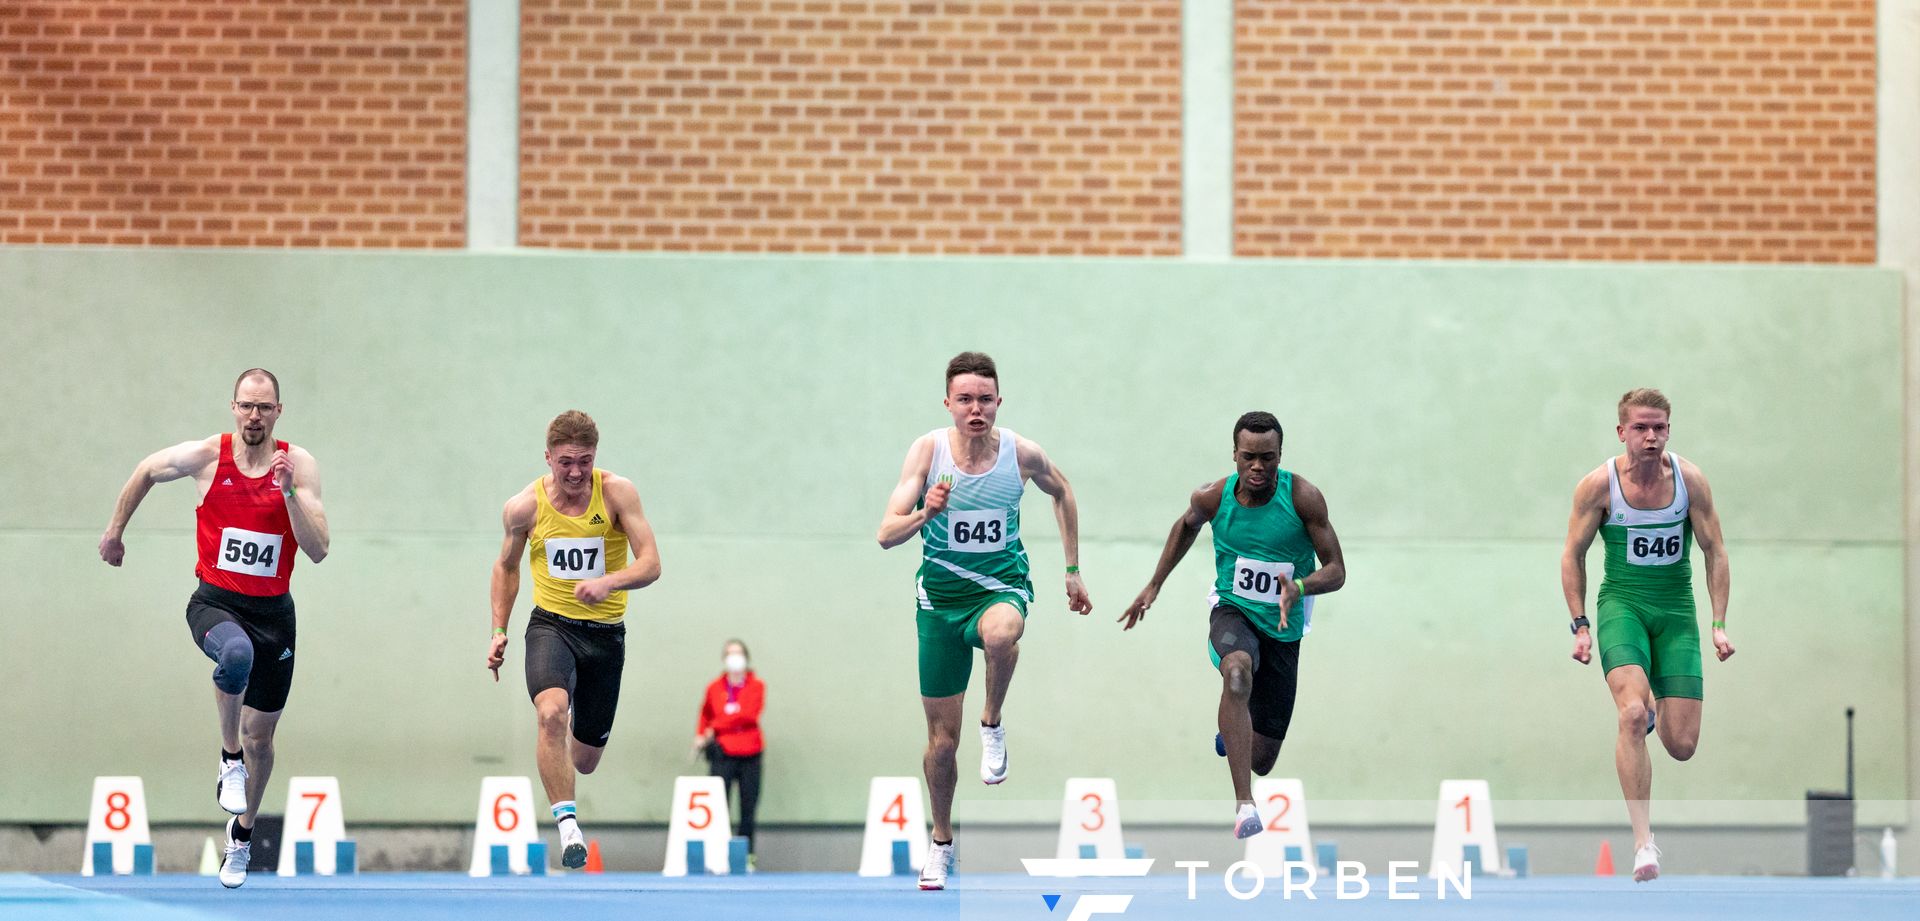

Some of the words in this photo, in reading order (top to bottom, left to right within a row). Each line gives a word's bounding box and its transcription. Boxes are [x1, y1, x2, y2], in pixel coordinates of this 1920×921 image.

[954, 520, 1002, 544] 643
[1633, 535, 1680, 558] 646
[224, 538, 275, 568] 594
[552, 548, 599, 572] 407
[104, 792, 131, 831] 8
[301, 793, 327, 832] 7
[492, 793, 519, 832] 6
[687, 791, 712, 830] 5
[881, 793, 909, 831] 4
[1080, 793, 1105, 832] 3
[1266, 794, 1291, 832] 2
[1454, 795, 1472, 833] 1
